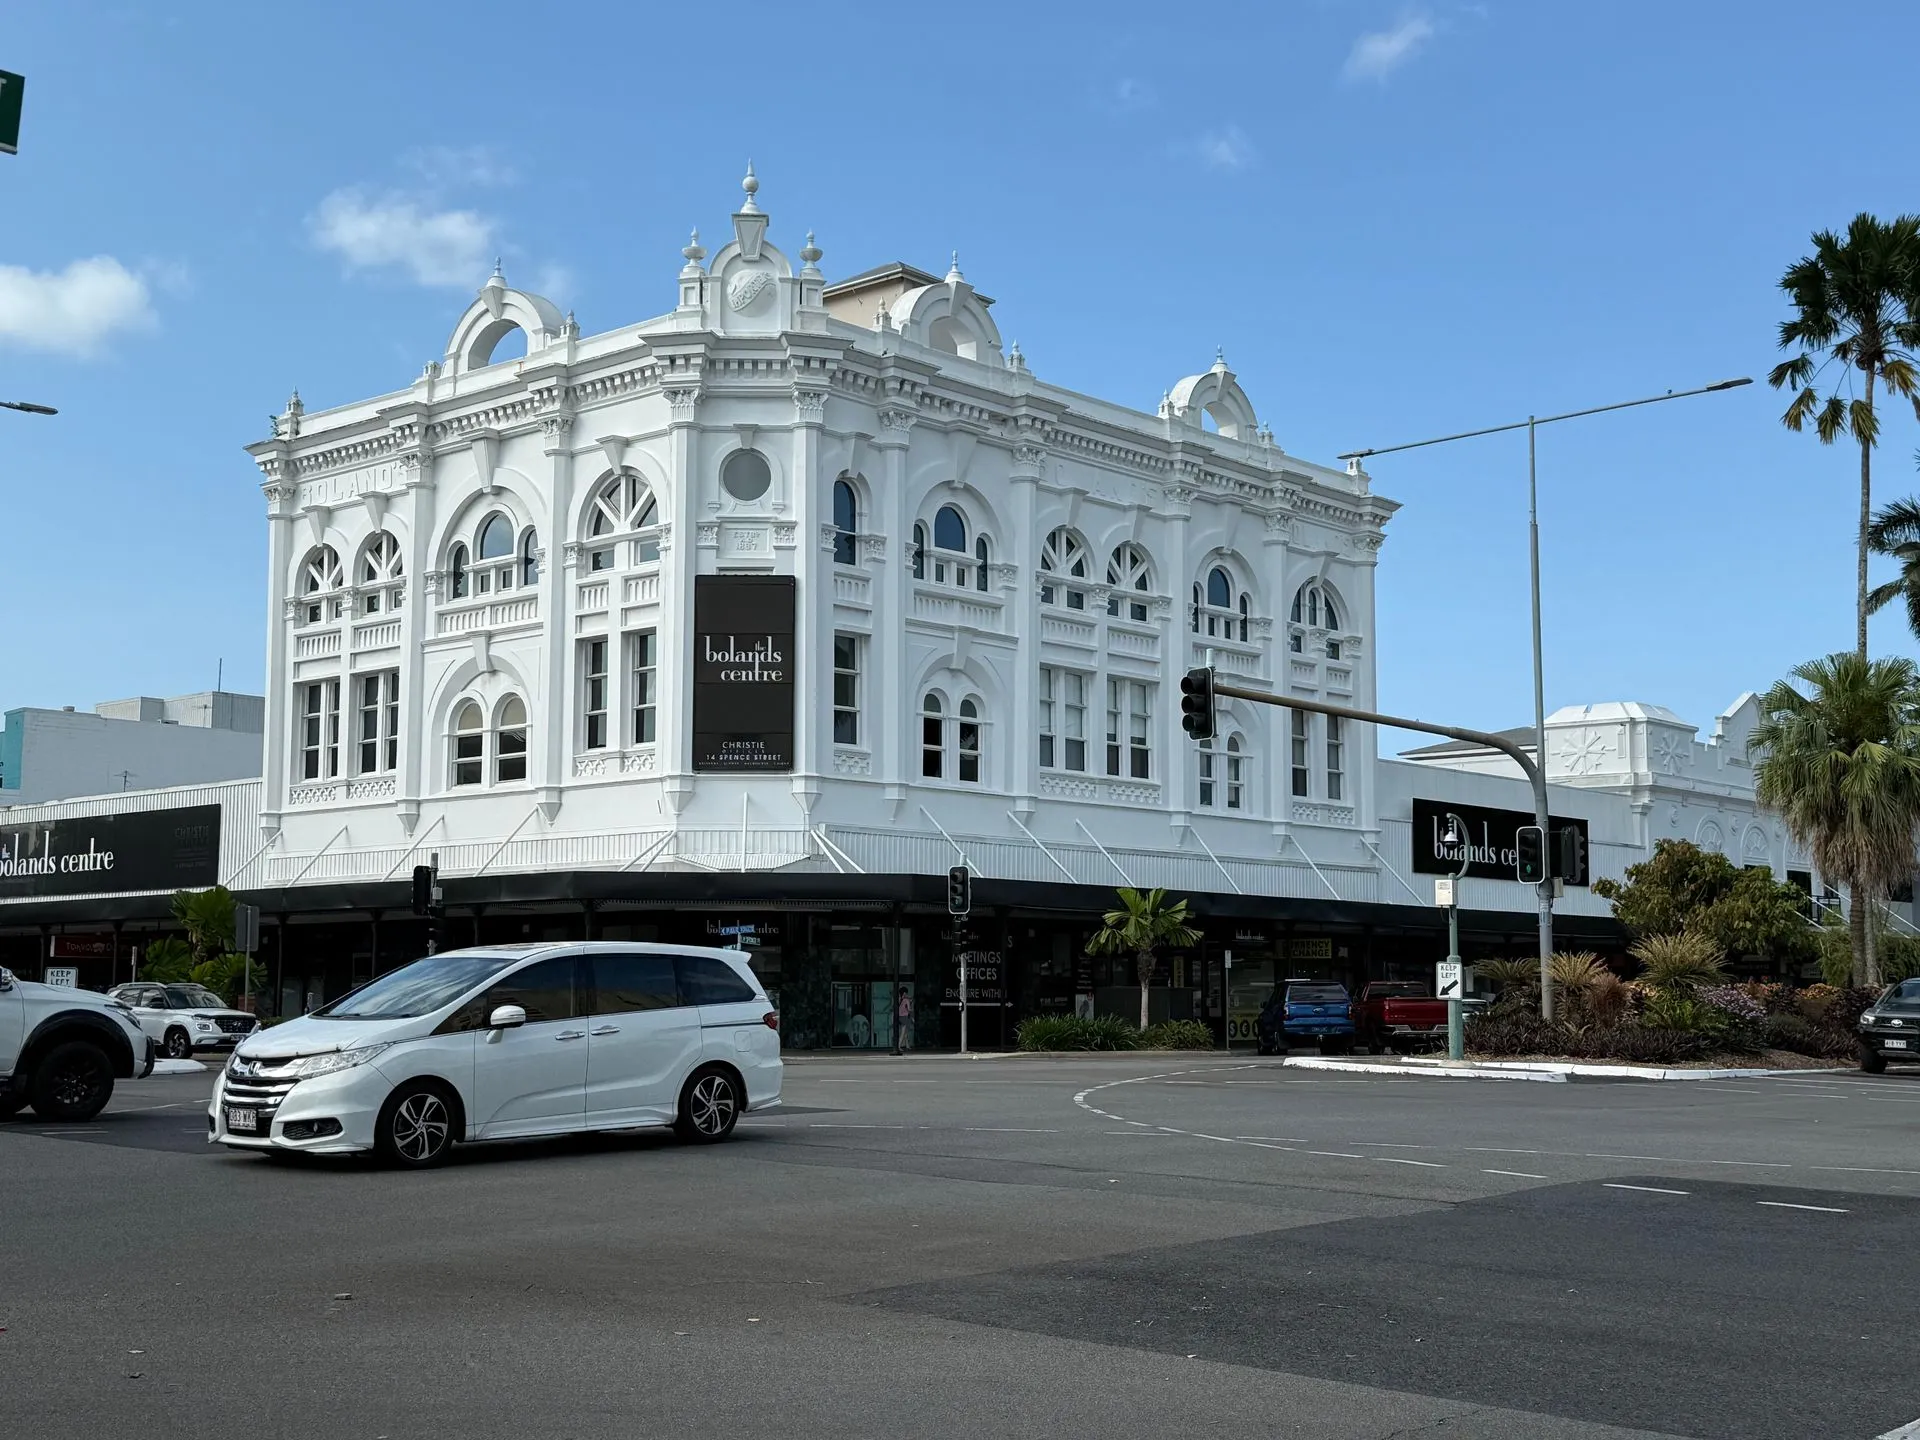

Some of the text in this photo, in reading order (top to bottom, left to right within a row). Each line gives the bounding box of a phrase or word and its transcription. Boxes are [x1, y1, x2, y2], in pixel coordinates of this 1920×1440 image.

[704, 635, 782, 663] bolands
[721, 661, 783, 681] centre
[722, 741, 765, 749] CHRISTIE
[60, 837, 115, 873] centre
[951, 951, 1001, 964] METINGS
[50, 970, 71, 978] KEEP
